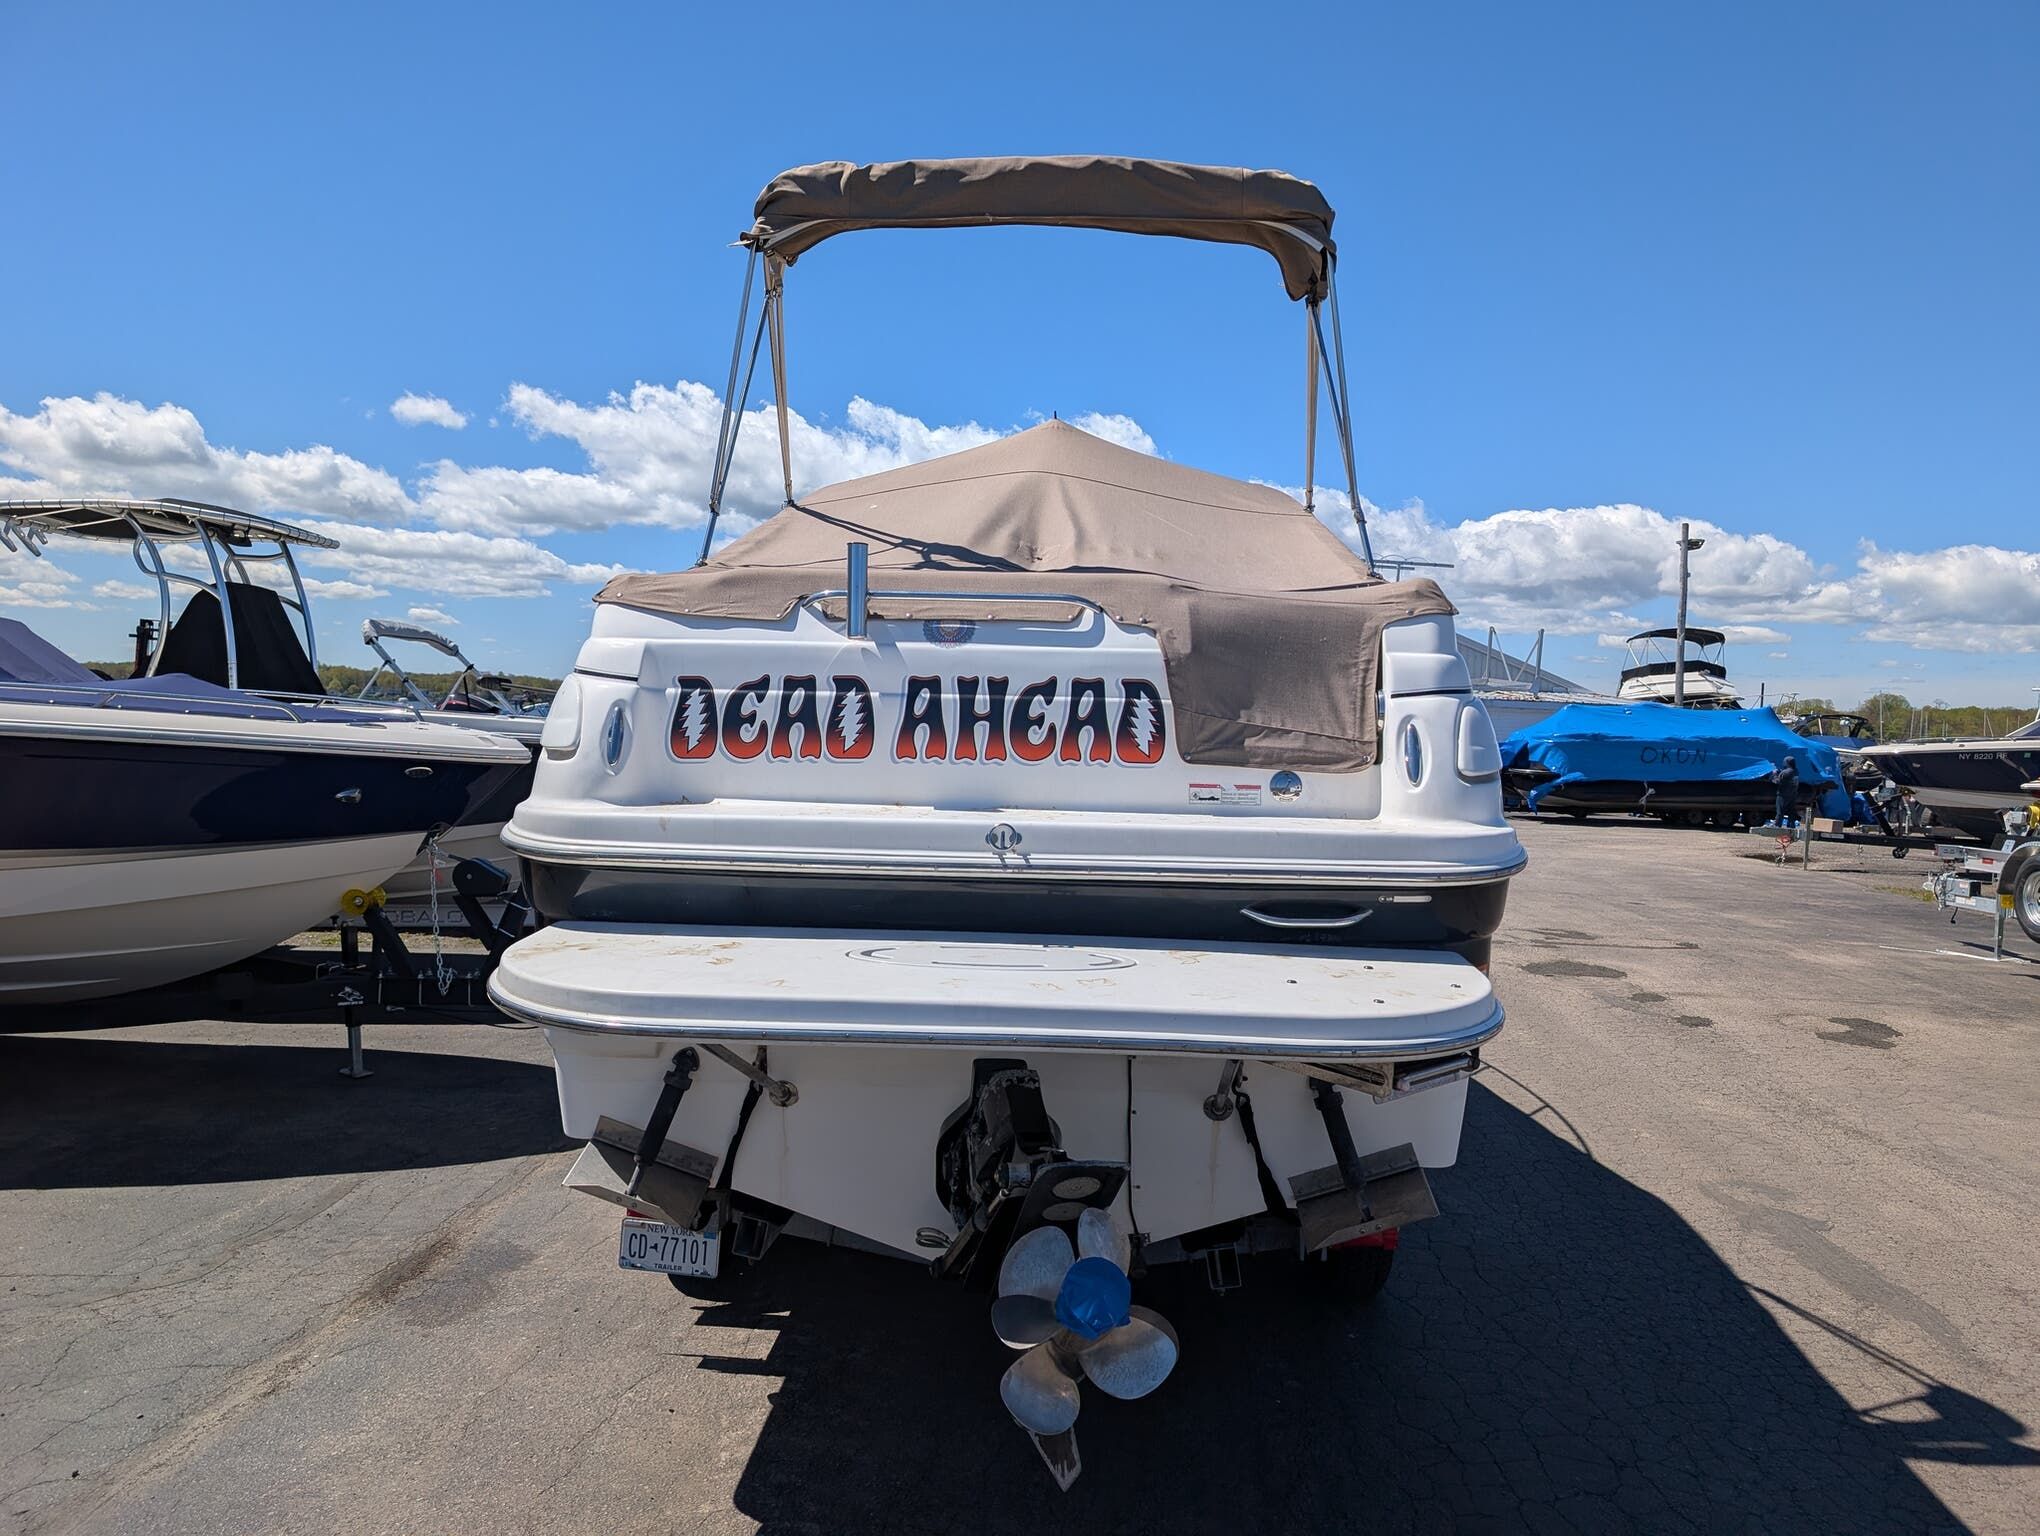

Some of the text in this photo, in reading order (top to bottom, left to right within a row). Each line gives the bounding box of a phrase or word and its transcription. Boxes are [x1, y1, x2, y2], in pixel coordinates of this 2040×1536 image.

[669, 674, 1166, 763] DEAD AHEAD
[647, 1223, 696, 1237] NEW YORK
[654, 1263, 683, 1271] TRAILER
